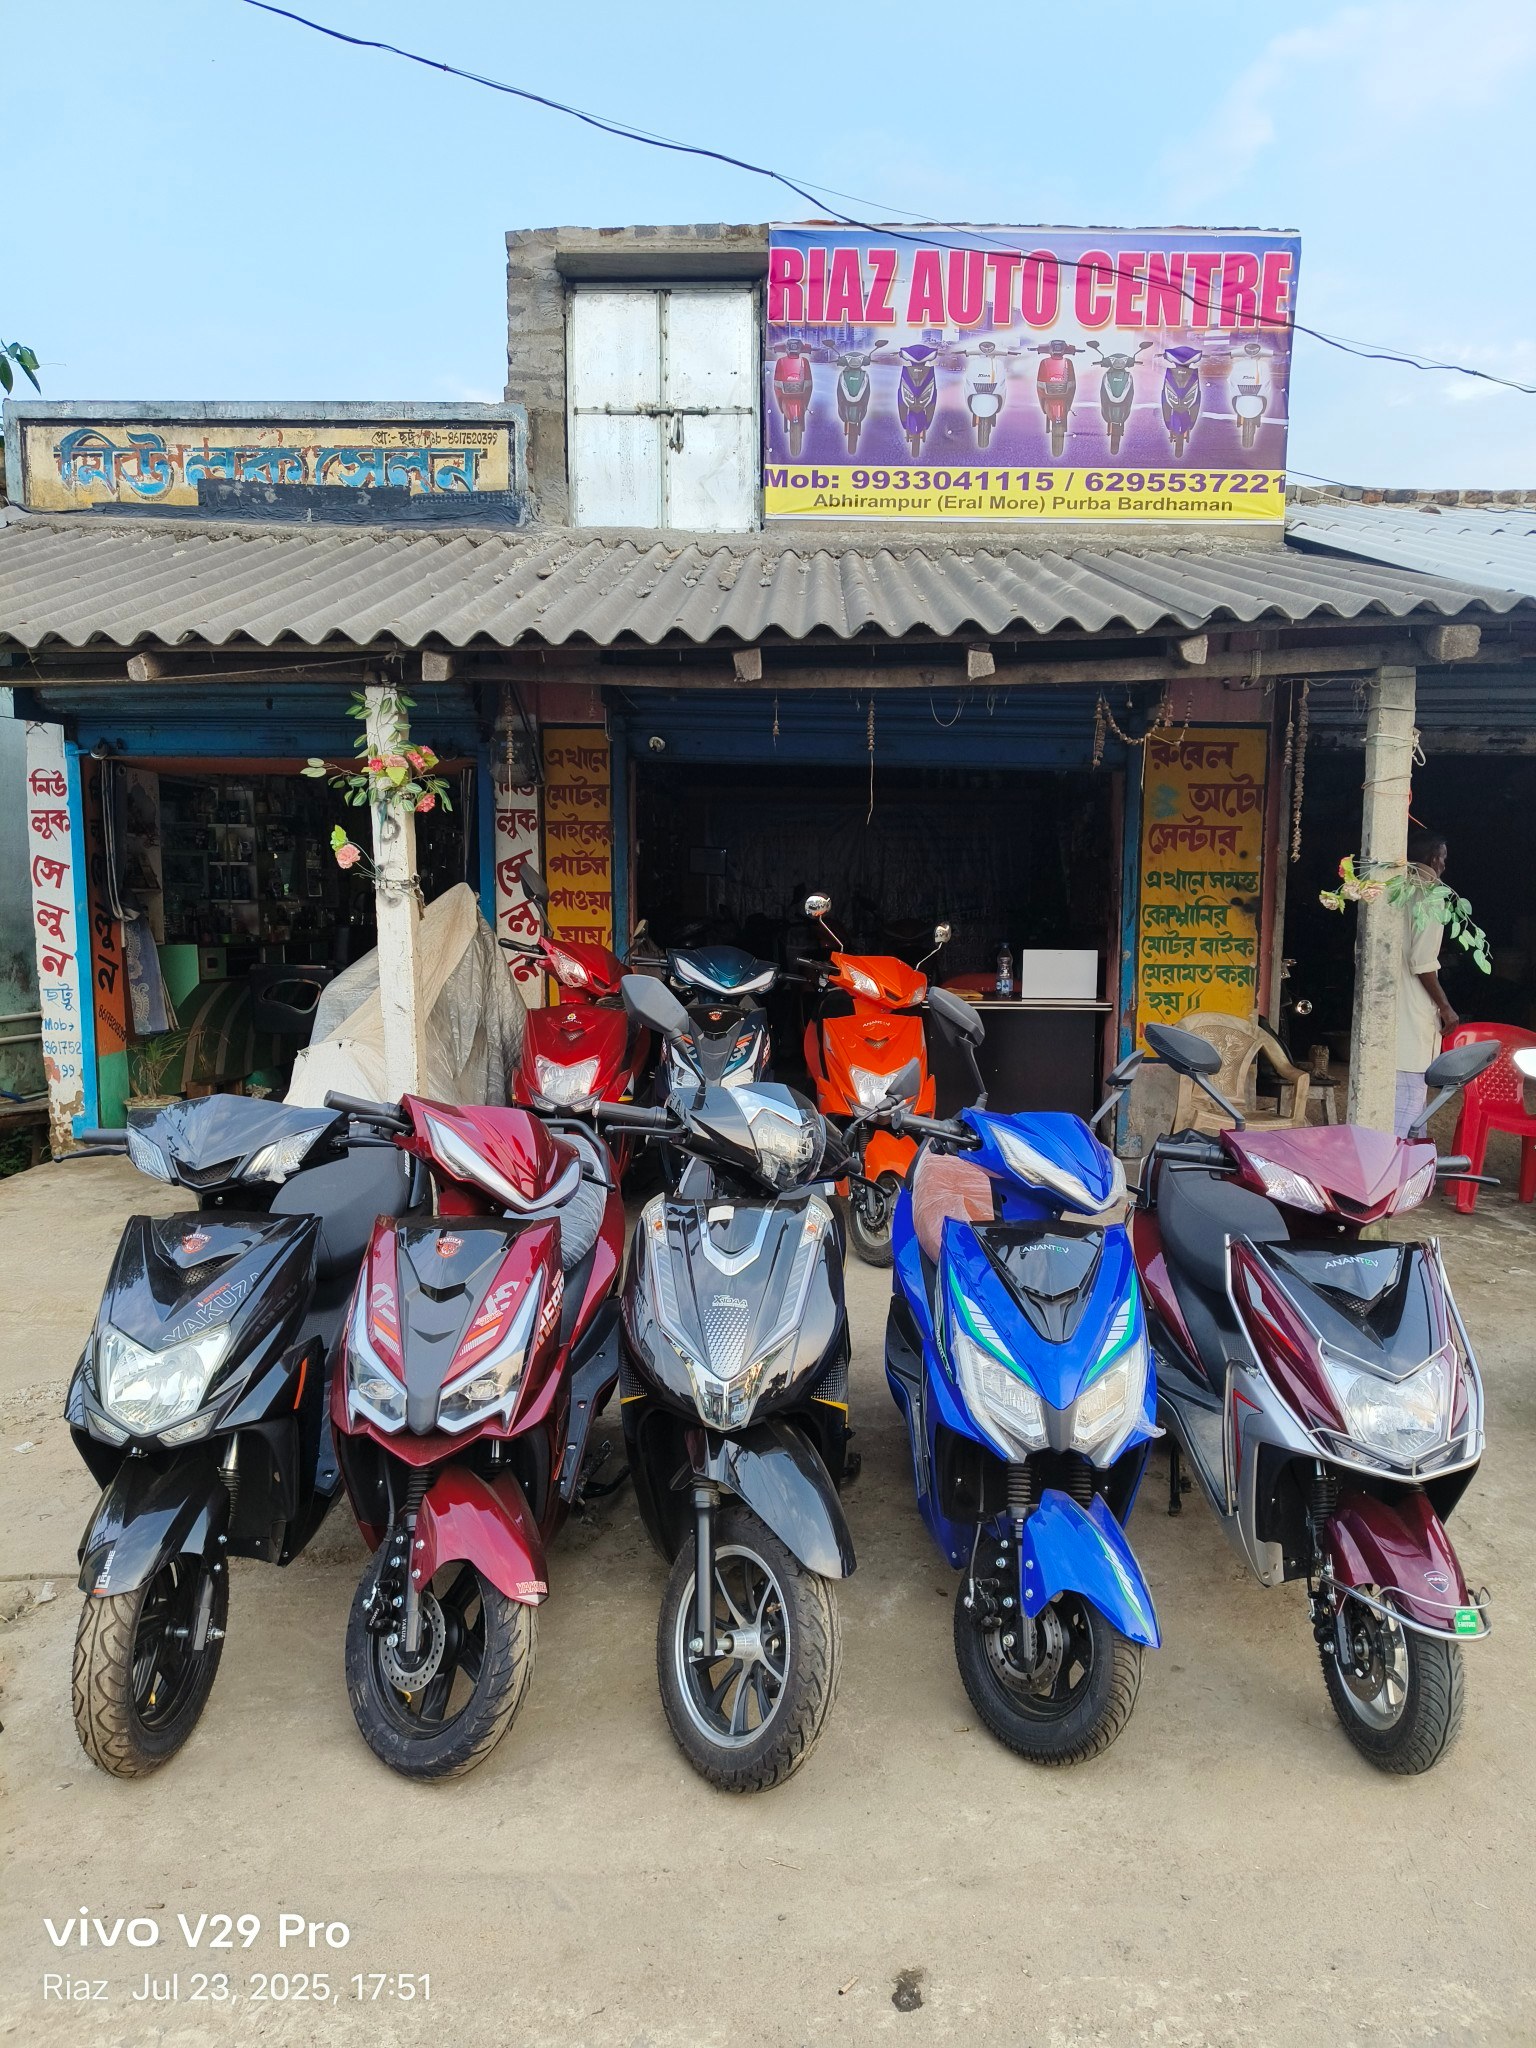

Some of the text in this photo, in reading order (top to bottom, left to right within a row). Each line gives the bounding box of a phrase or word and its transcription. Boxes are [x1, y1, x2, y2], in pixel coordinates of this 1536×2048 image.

[768, 246, 1292, 328] RIAZ AUTO CENTRE
[764, 469, 1286, 494] Mob: 9933041115 / 6295537221
[813, 494, 1233, 514] Abhirampur (Eral More) Purba Bardhaman
[545, 747, 608, 773] এখানে
[29, 768, 68, 798] নিউ
[546, 775, 611, 810] মোটর
[1188, 772, 1265, 818] অটো
[31, 809, 71, 842] লুক
[546, 813, 614, 848] বাইকের
[1148, 814, 1243, 856] সেন্টার
[1144, 868, 1259, 895] এখানে সমস্ত
[549, 887, 612, 916] পাওয়া
[1141, 929, 1255, 960] মোটর বাইক
[1142, 964, 1256, 988] মেরামত করা
